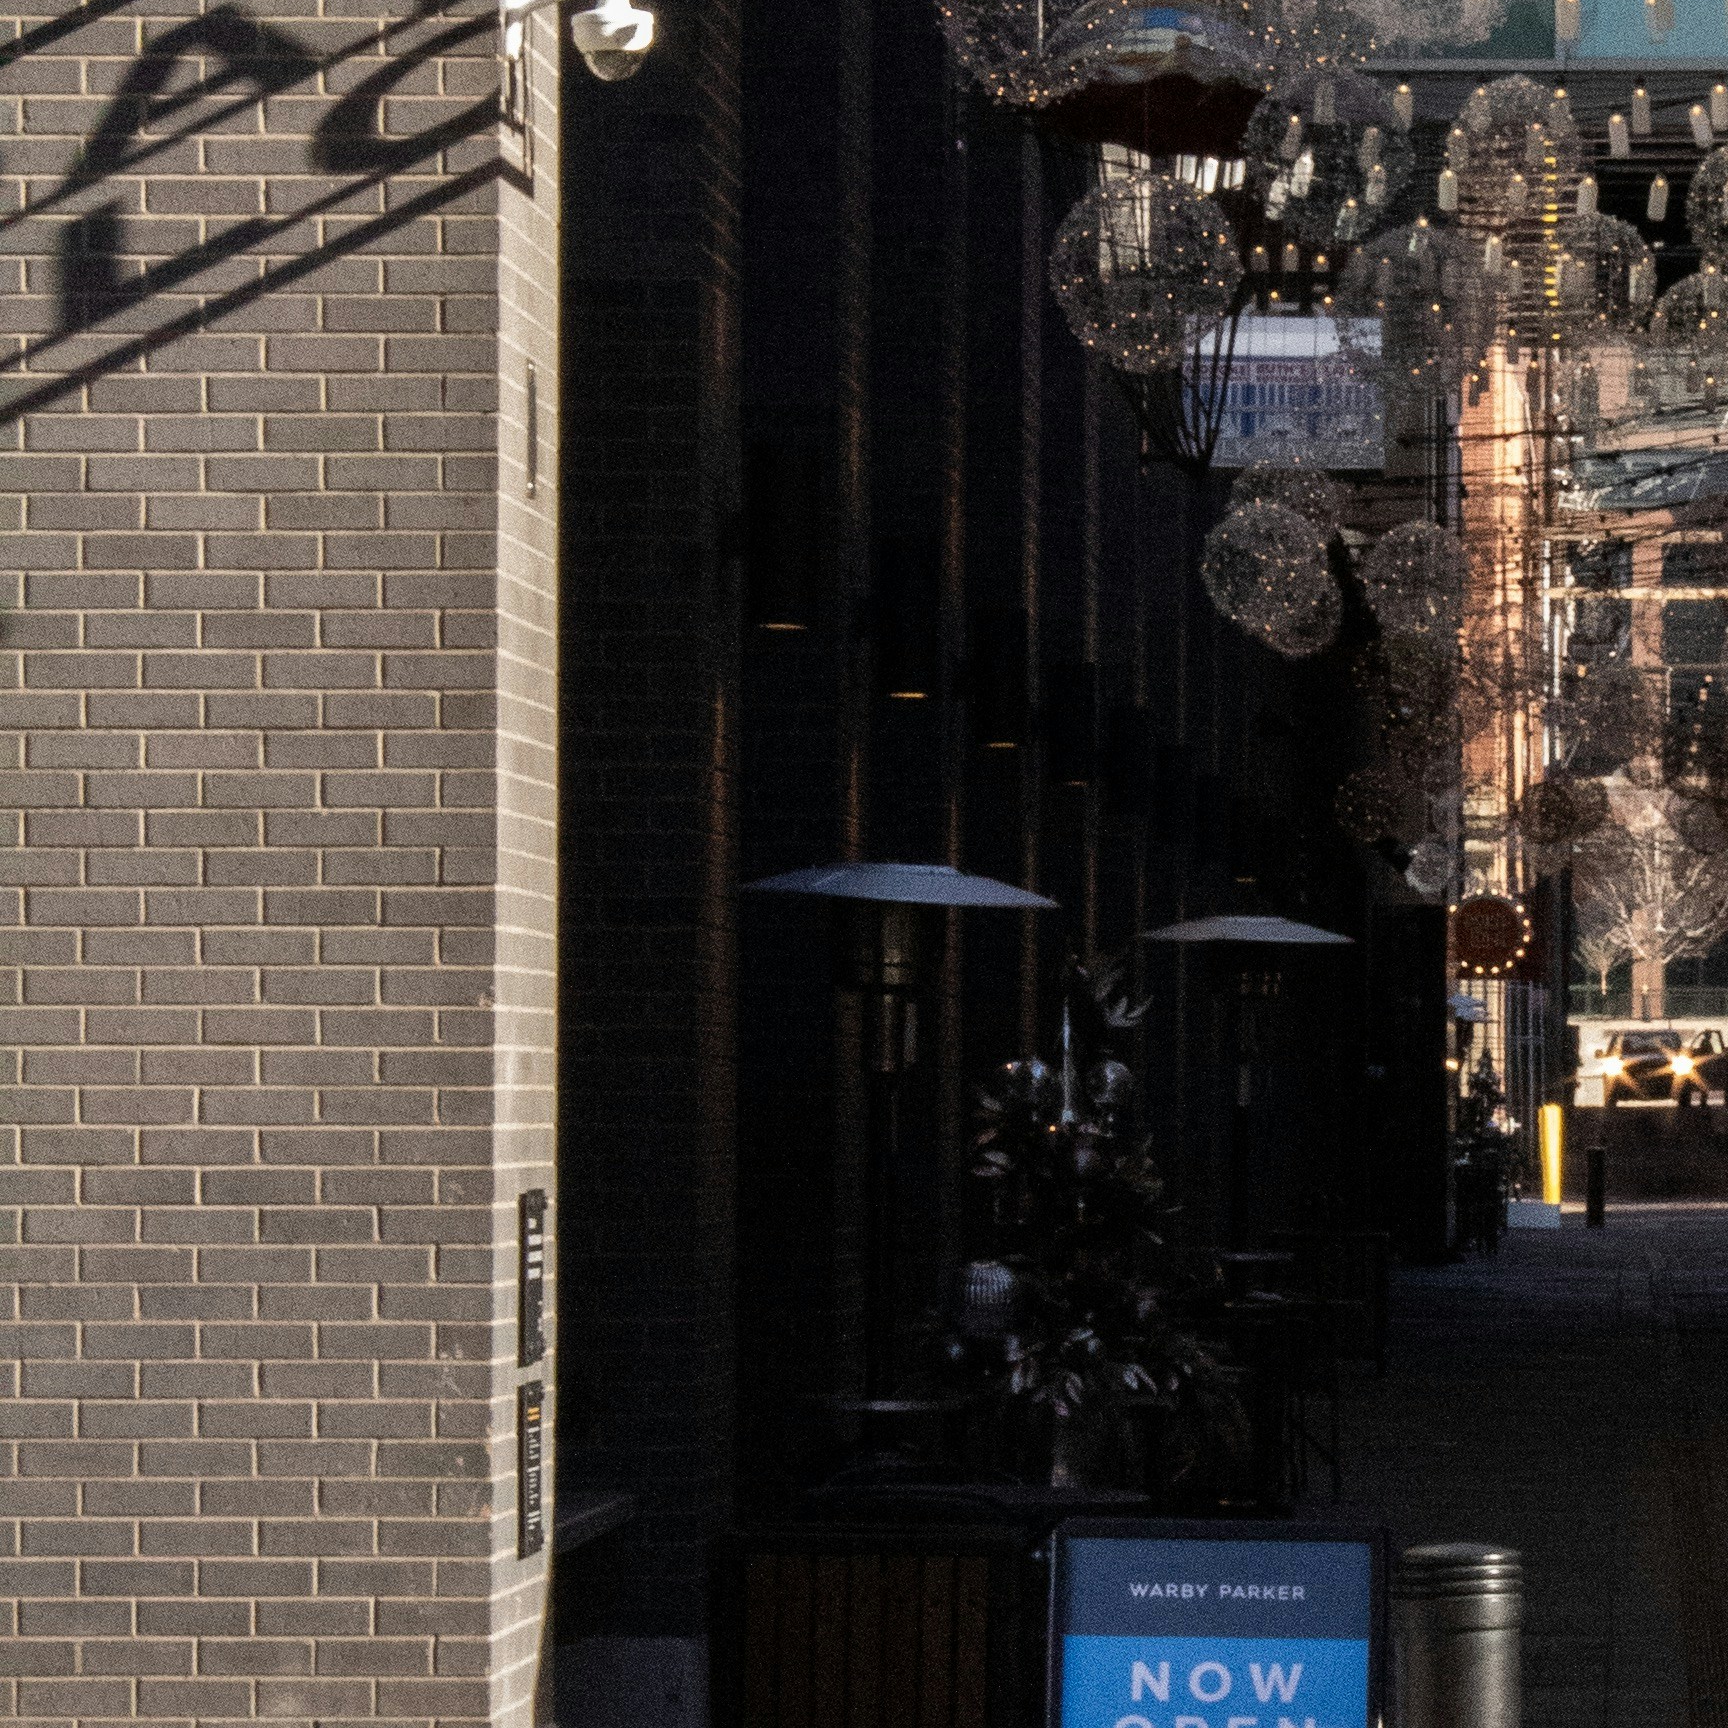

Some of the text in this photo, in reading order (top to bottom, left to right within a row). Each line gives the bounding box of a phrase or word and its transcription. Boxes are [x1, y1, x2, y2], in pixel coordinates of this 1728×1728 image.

[1129, 1581, 1306, 1601] WARBY PARKER
[1131, 1660, 1303, 1704] NOW
